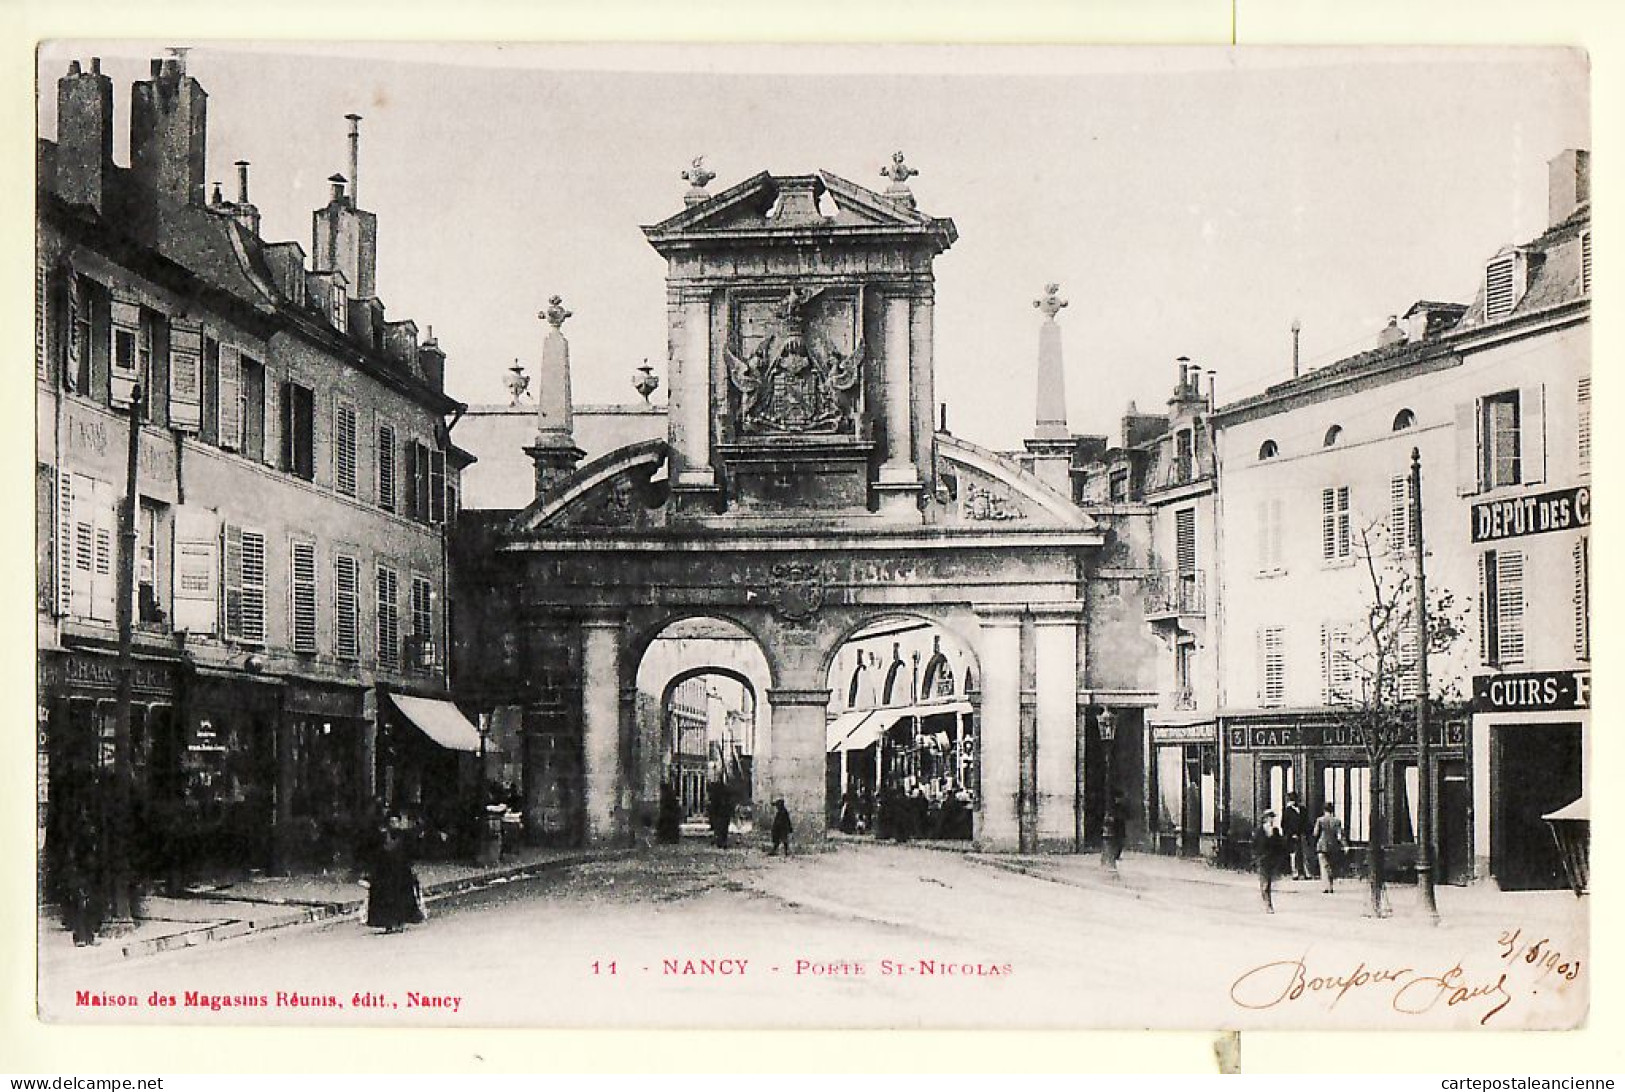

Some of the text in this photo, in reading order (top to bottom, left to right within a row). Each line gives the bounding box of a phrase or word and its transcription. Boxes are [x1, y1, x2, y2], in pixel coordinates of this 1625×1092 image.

[1540, 497, 1570, 531] DES
[591, 960, 617, 975] 11
[663, 959, 748, 975] NANCY
[1231, 954, 1413, 1012] Bonjour
[75, 990, 139, 1007] Maison
[147, 990, 177, 1008] des
[184, 991, 268, 1013] Magasins
[275, 991, 344, 1010] Réunis,
[406, 991, 461, 1013] Nancy
